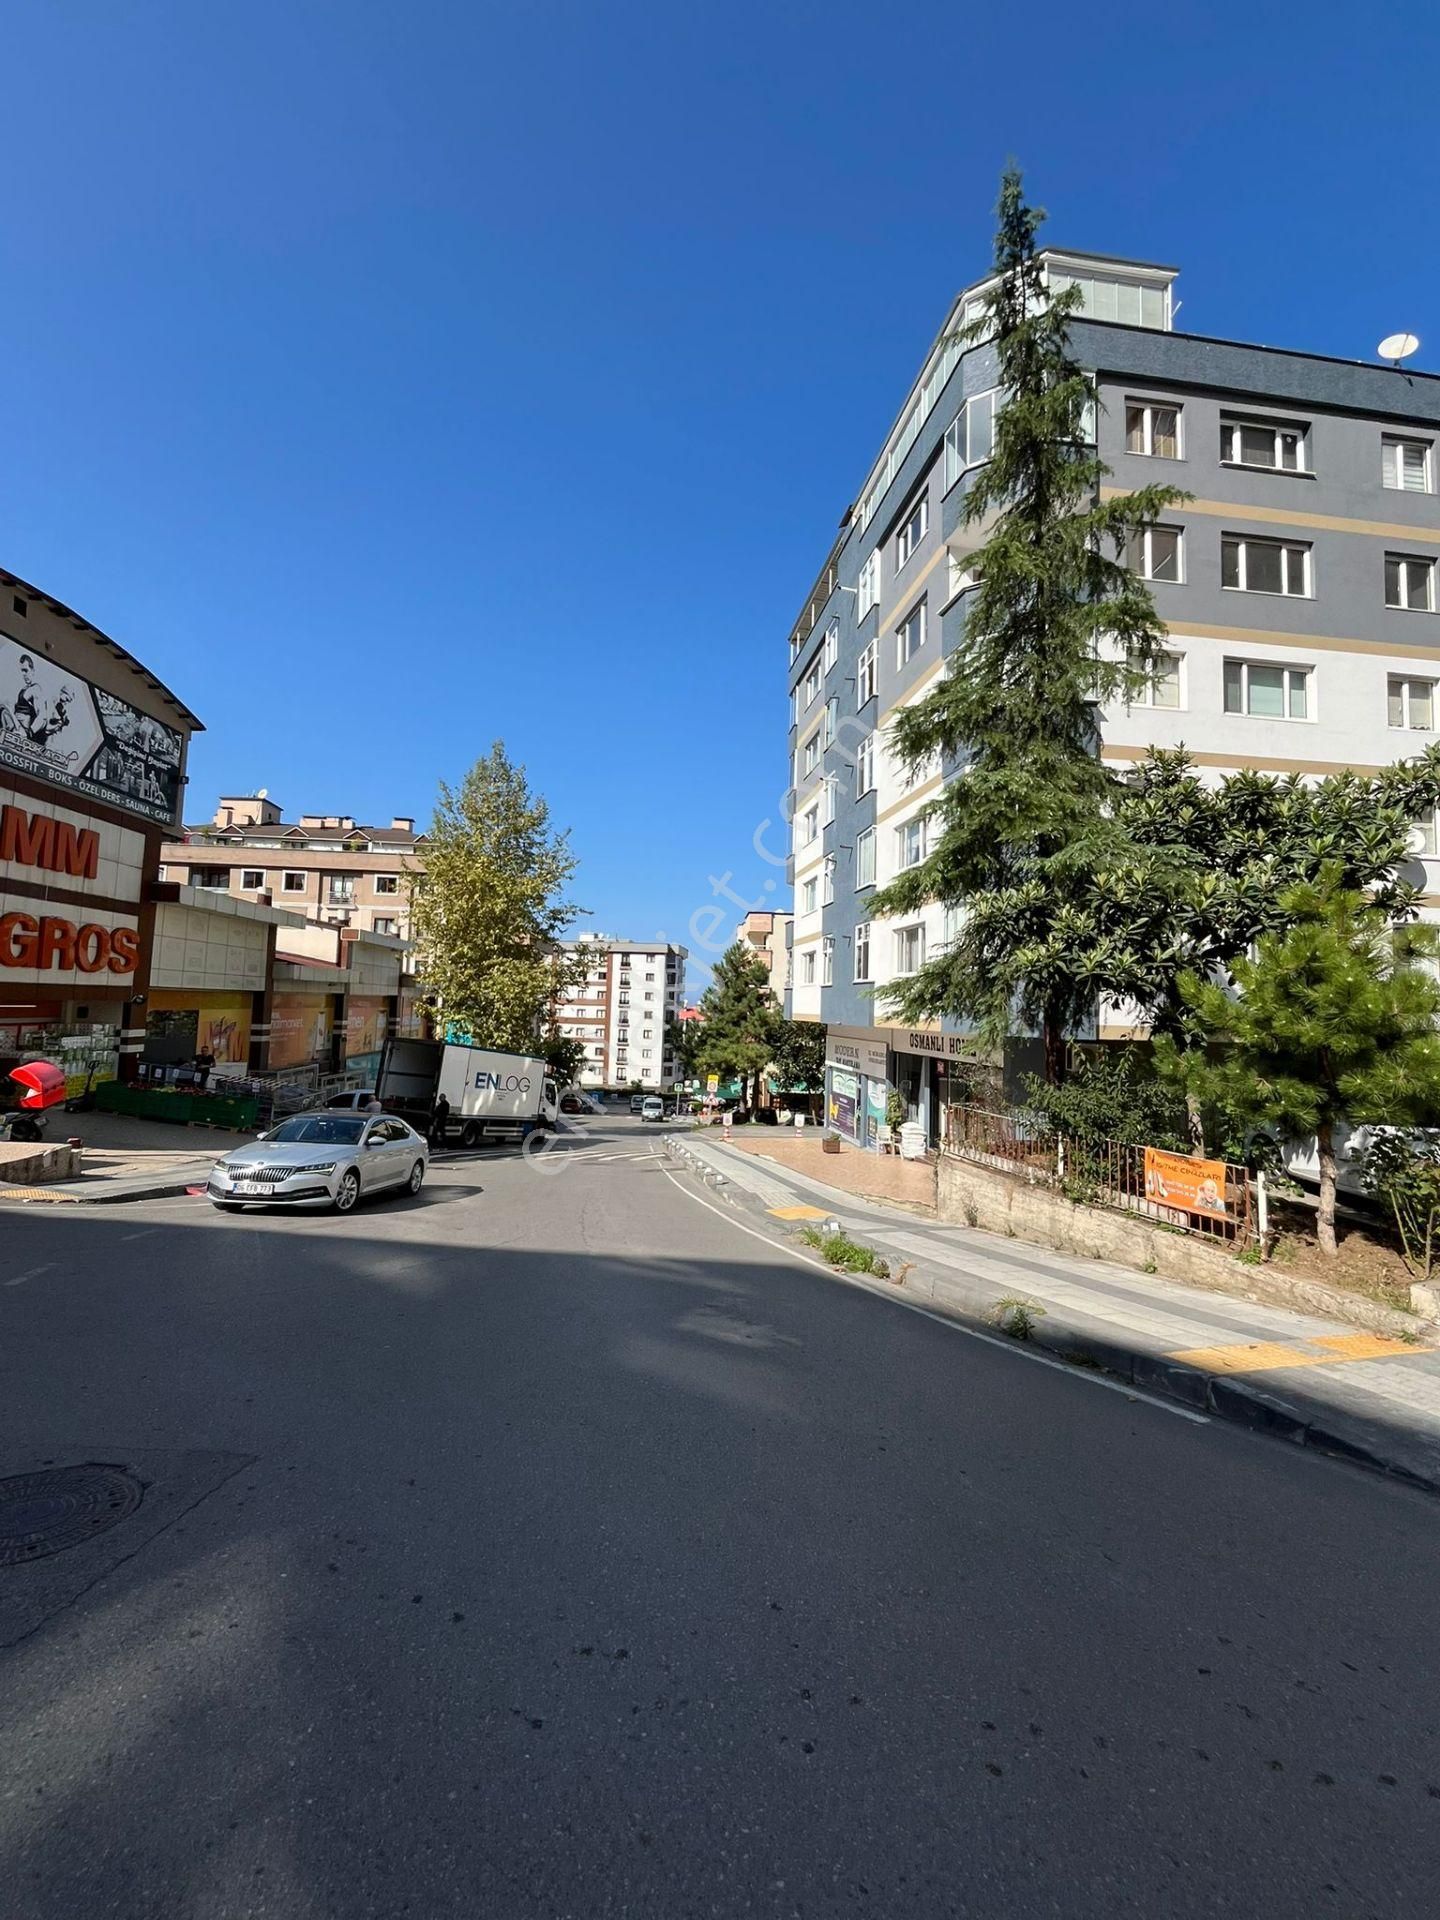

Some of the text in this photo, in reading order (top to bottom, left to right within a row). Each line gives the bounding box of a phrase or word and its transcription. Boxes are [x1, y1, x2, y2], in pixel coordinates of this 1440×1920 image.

[47, 769, 73, 787] BOKS
[101, 789, 121, 804] DERS
[125, 799, 150, 815] SAUNA
[154, 809, 171, 823] CAFE
[0, 911, 140, 974] GROS
[909, 1033, 945, 1052] OSMANLI
[474, 1071, 531, 1093] ENLOG
